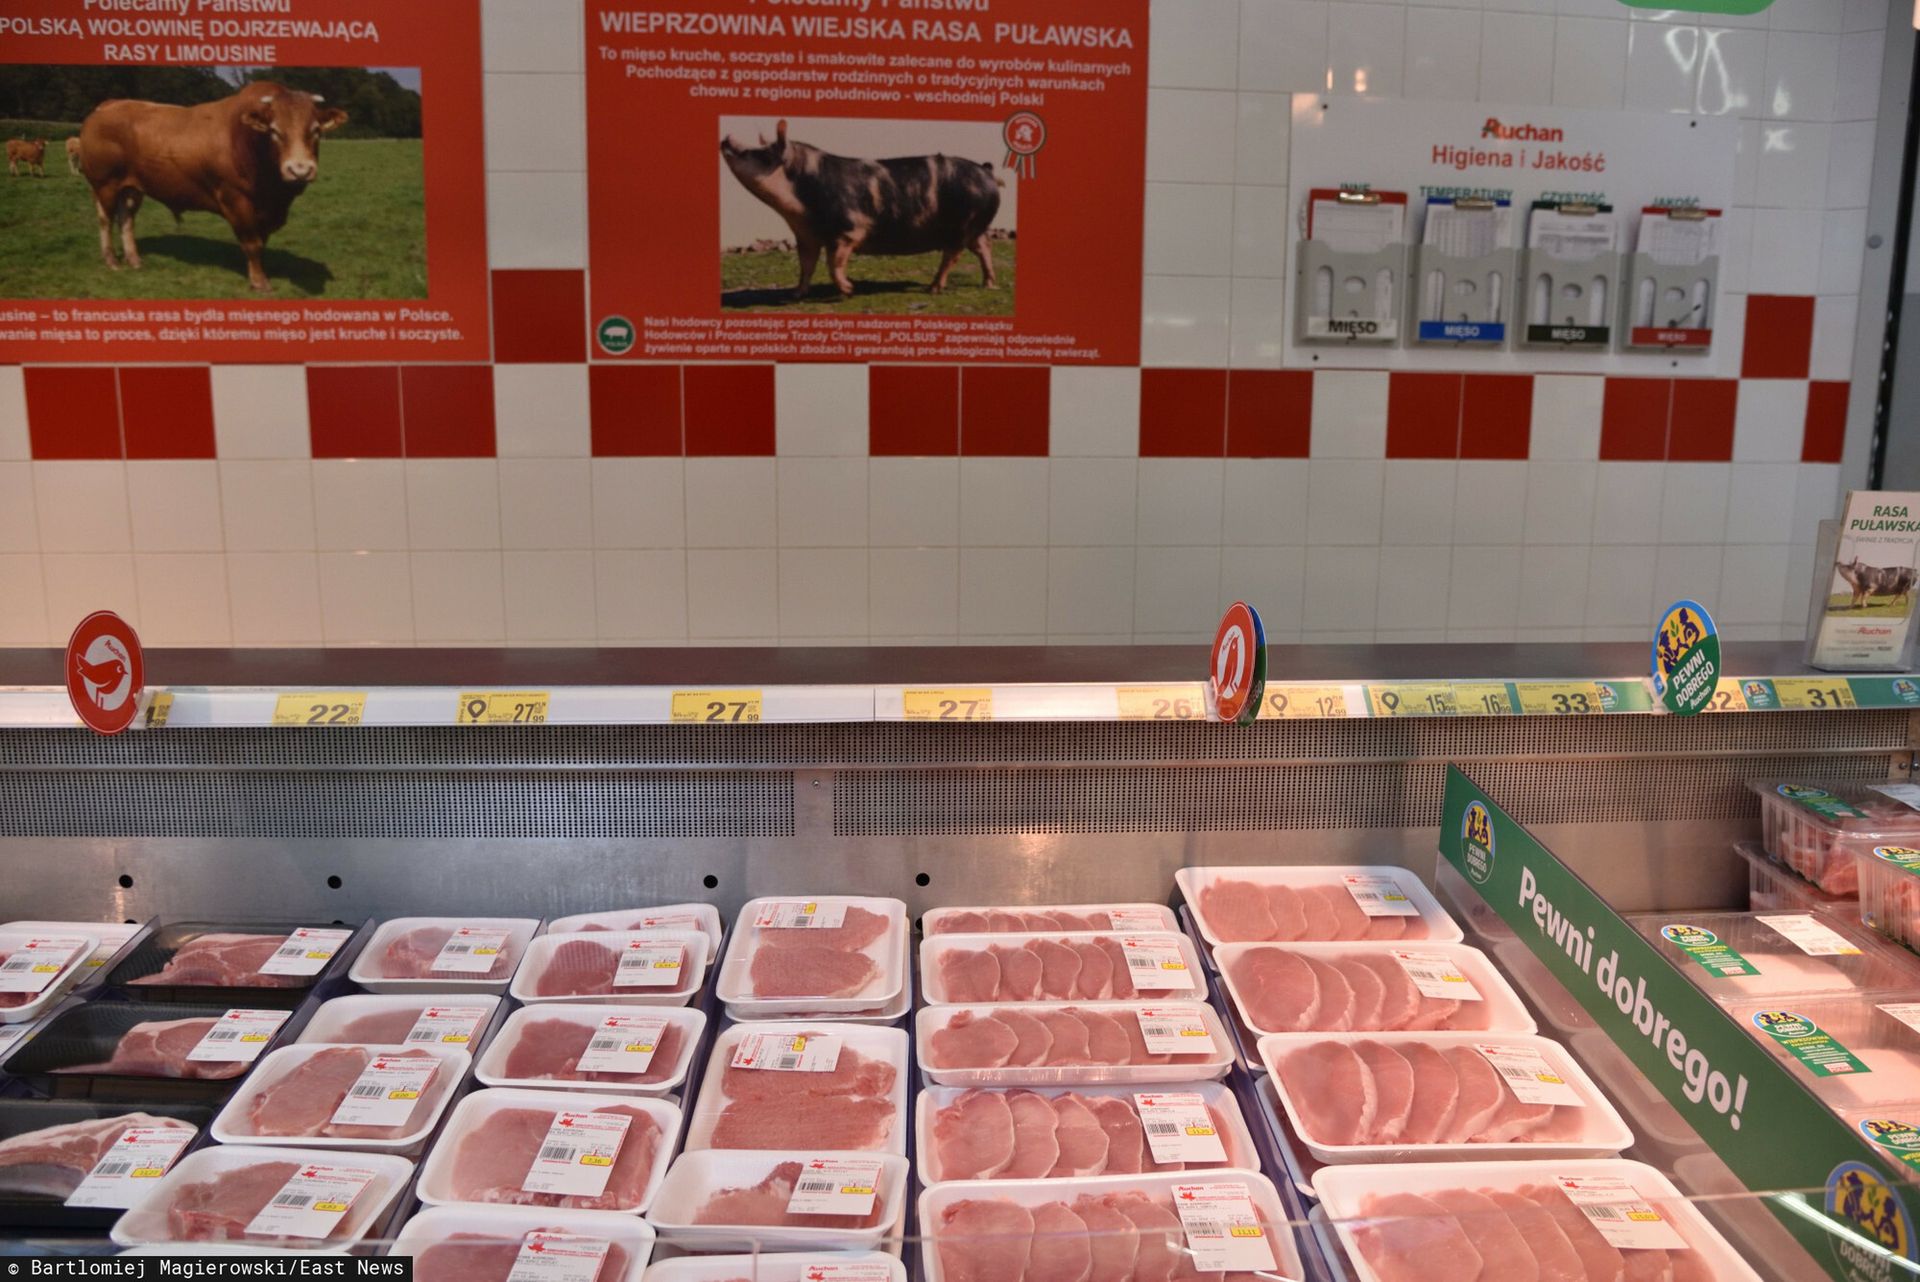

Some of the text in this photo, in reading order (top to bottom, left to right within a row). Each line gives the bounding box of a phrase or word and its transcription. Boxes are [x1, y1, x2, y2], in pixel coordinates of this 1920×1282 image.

[0, 17, 379, 43] POLSKĄ WOŁOWINĘ DOJRZEWAJĄCĄ
[600, 11, 1133, 48] WIEPRZOWINA WIEJSKA RASA PUŁAWSKA
[103, 44, 277, 62] RASY LIMOUSINE
[600, 47, 1131, 77] To mięso kruche, soczyste i smakowite zalecane do wyrobów kulinarnych
[626, 64, 1105, 92] Pochodzące z gospodarstw rodzinnych o tradycyjnych warunkach
[690, 83, 739, 98] chowu
[742, 87, 752, 98] z
[755, 86, 812, 102] regionu
[815, 87, 902, 102] południowo
[914, 90, 997, 107] wschodniej
[1000, 91, 1044, 106] Polski
[1481, 116, 1564, 142] Auchan
[1432, 145, 1606, 173] Higiena i Jakość
[53, 309, 68, 322] to
[72, 309, 145, 322] francuska
[149, 311, 180, 322] rasa
[184, 309, 225, 324] bydła
[228, 309, 300, 324] mięsnego
[303, 309, 380, 322] hodowana
[383, 311, 396, 322] w
[400, 308, 454, 322] Polsce.
[40, 328, 81, 344] mięsa
[85, 329, 99, 341] to
[159, 328, 200, 344] dzięki
[203, 328, 261, 341] któremu
[264, 328, 307, 344] mięso
[309, 328, 336, 344] jest
[339, 328, 387, 341] kruche
[399, 329, 465, 344] soczyste.
[1444, 324, 1481, 338] MIĘSO
[1552, 328, 1587, 342] MIĘSO
[1873, 505, 1908, 518] RASA
[1672, 648, 1706, 690] PEWNI
[1675, 661, 1716, 708] DOBREGO
[1315, 696, 1336, 717] 12
[1425, 693, 1446, 714] 15
[1481, 694, 1500, 715] 16
[1552, 693, 1592, 714] 33
[1690, 685, 1712, 710] Auchan
[1806, 688, 1843, 708] 31
[307, 704, 350, 724] 22
[513, 703, 535, 723] 27
[706, 701, 748, 722] 27
[939, 699, 979, 720] 27
[1151, 698, 1193, 719] 26
[1469, 842, 1487, 862] PEWNI
[1518, 865, 1749, 1131] Pewni dobrego!
